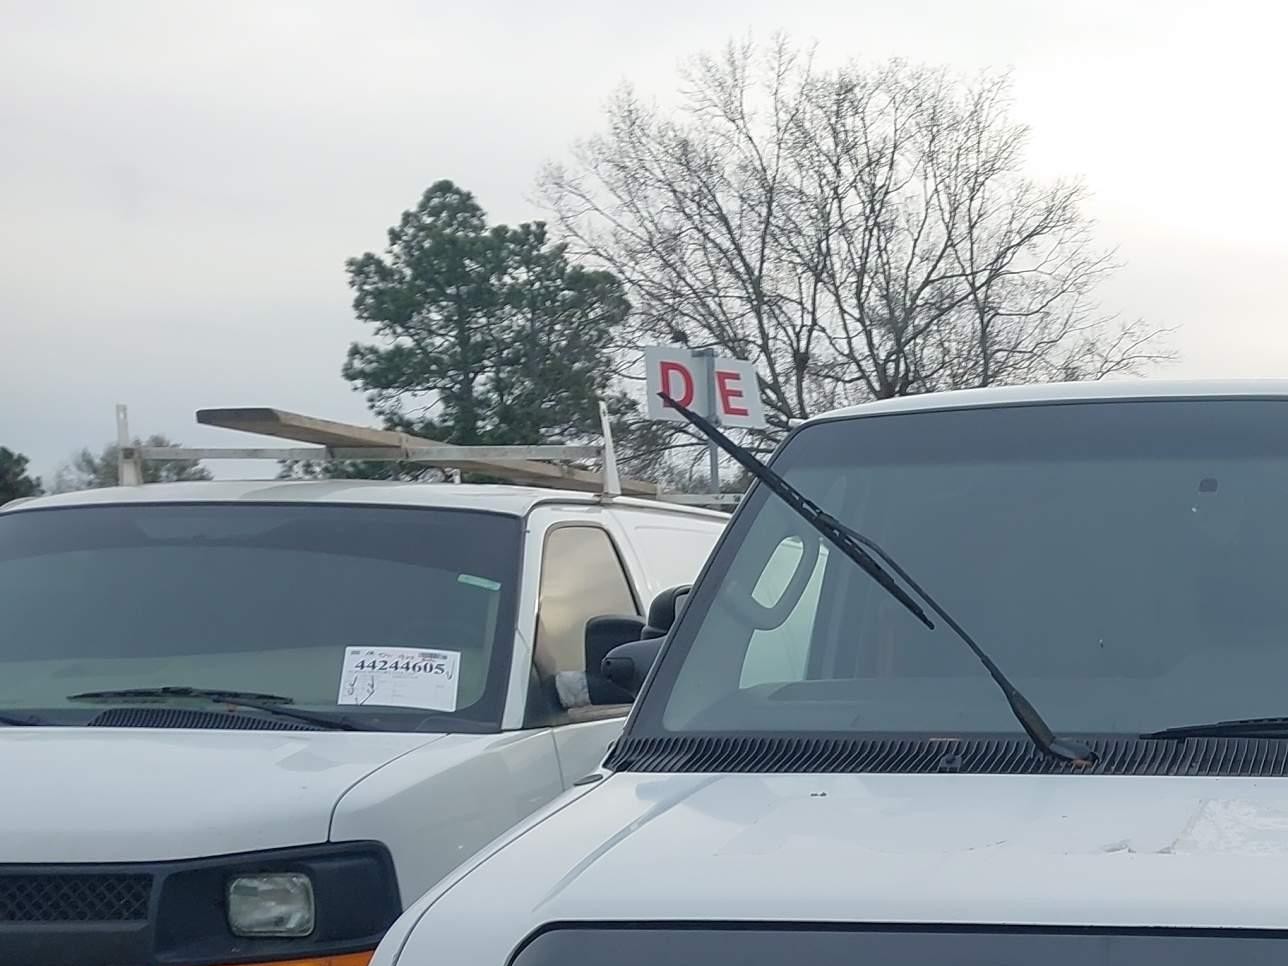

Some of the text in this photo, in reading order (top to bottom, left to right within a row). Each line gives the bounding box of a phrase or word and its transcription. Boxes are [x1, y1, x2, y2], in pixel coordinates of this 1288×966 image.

[660, 361, 694, 408] D
[716, 371, 749, 416] E
[354, 659, 446, 675] 44244605
